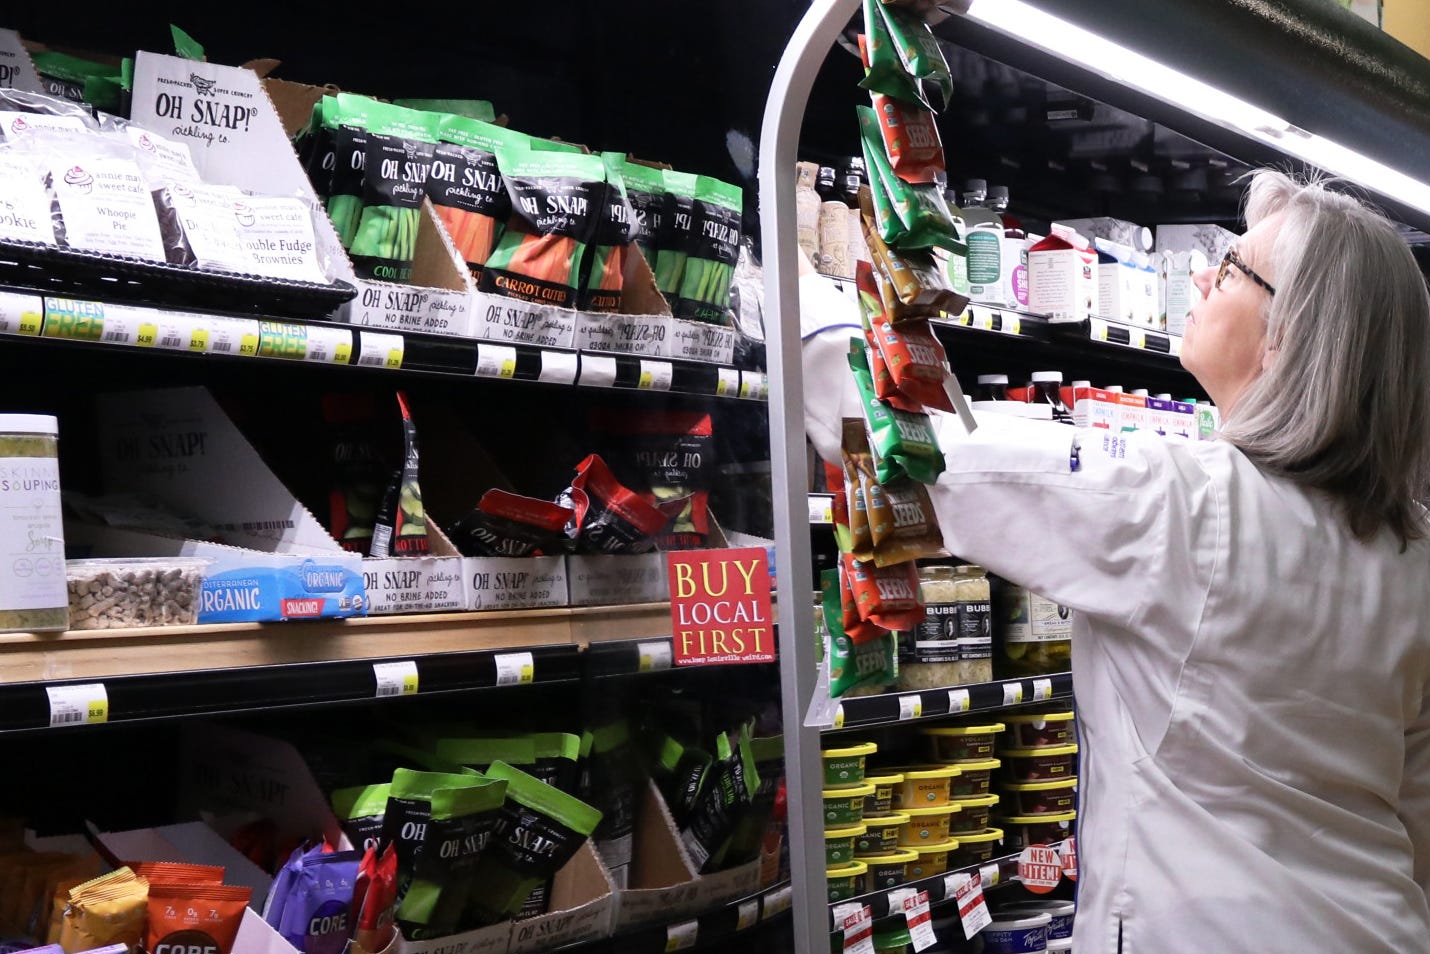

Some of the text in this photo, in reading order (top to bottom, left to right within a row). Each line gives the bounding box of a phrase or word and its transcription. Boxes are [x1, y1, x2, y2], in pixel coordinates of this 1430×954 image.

[155, 92, 183, 119] OH
[905, 125, 936, 148] SEEDS
[380, 158, 399, 180] OH
[430, 160, 456, 183] OH
[96, 206, 137, 220] Whoopie
[519, 195, 587, 217] OH SNAP!
[112, 221, 127, 231] Pie
[279, 239, 312, 255] Fudge
[495, 276, 541, 297] CARROT
[46, 297, 104, 316] GLUTEN
[362, 288, 380, 308] OH
[385, 313, 449, 329] NO BRINE ADDED
[486, 304, 502, 323] OH
[46, 314, 104, 337] FREE
[260, 321, 308, 339] GLUTEN
[260, 335, 307, 354] FREE
[503, 328, 557, 346] NO BRINE ADDED
[906, 342, 940, 366] SEEDS
[896, 421, 932, 444] SEEDS
[2, 480, 58, 491] SOUPING
[892, 502, 926, 528] SEEDS
[306, 572, 344, 588] ORGANIC
[473, 572, 489, 590] OH
[673, 559, 760, 598] BUY
[386, 591, 448, 602] NO BRINE ADDED
[530, 590, 550, 599] ADDED
[875, 578, 914, 600] SEEDS
[286, 600, 319, 614] SNACKING!
[678, 600, 765, 626] LOCAL
[681, 627, 767, 656] FIRST
[855, 652, 888, 676] SEEDS
[830, 762, 859, 770] ORGANIC
[401, 821, 427, 842] OH
[440, 839, 460, 859] OH
[1030, 849, 1054, 864] NEW
[1028, 865, 1060, 881] ITEM!
[309, 914, 348, 936] CORE
[518, 925, 533, 942] OH
